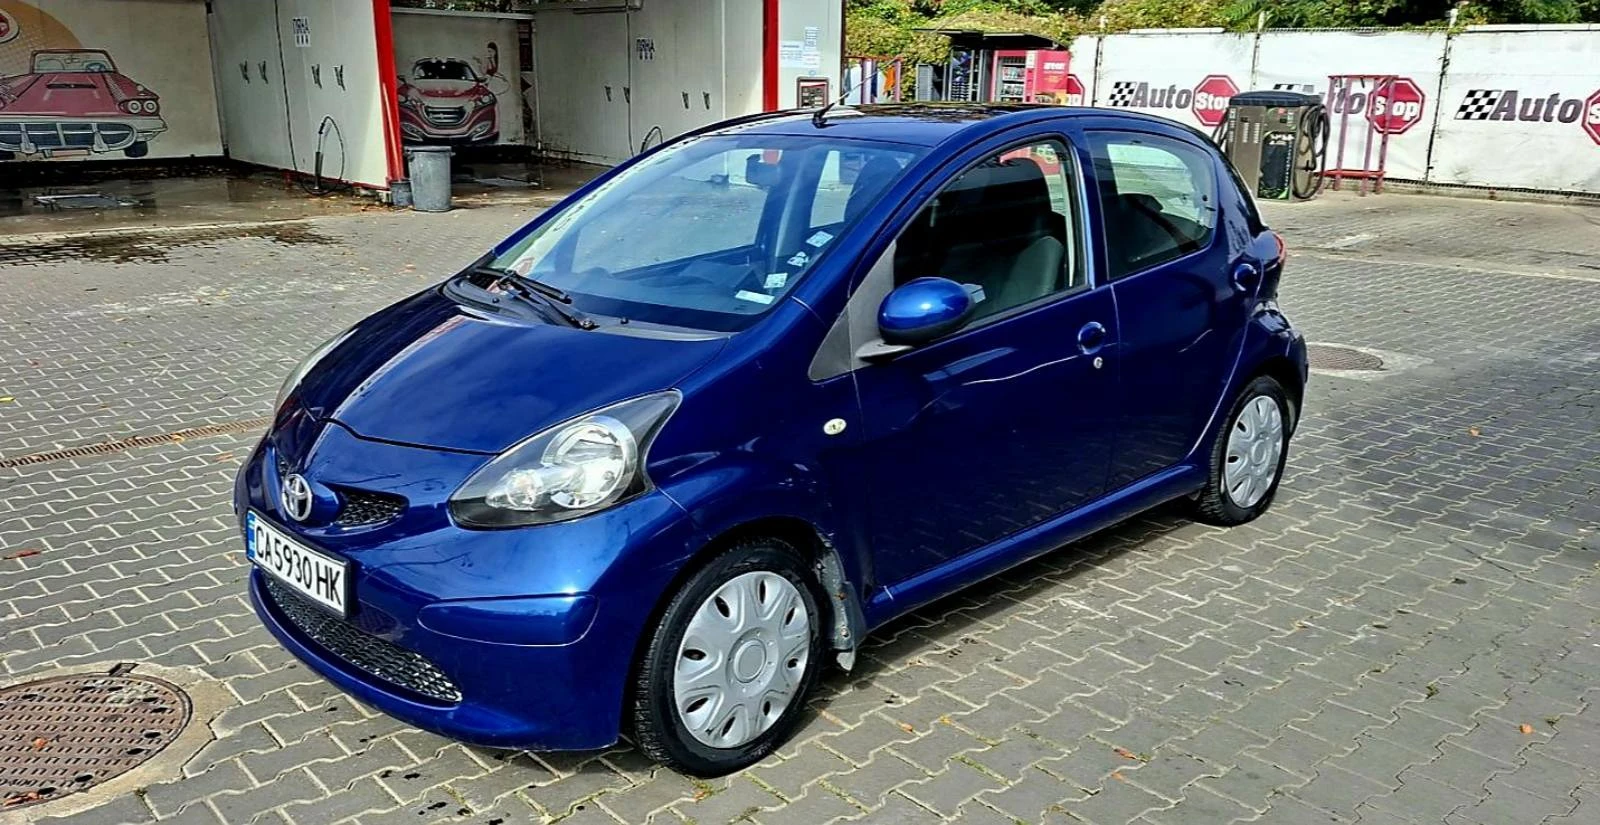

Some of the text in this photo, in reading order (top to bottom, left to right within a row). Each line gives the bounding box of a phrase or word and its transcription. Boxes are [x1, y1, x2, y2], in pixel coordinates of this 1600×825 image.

[1130, 82, 1193, 109] Auto
[1374, 96, 1419, 122] Sop
[1488, 90, 1583, 123] Auto
